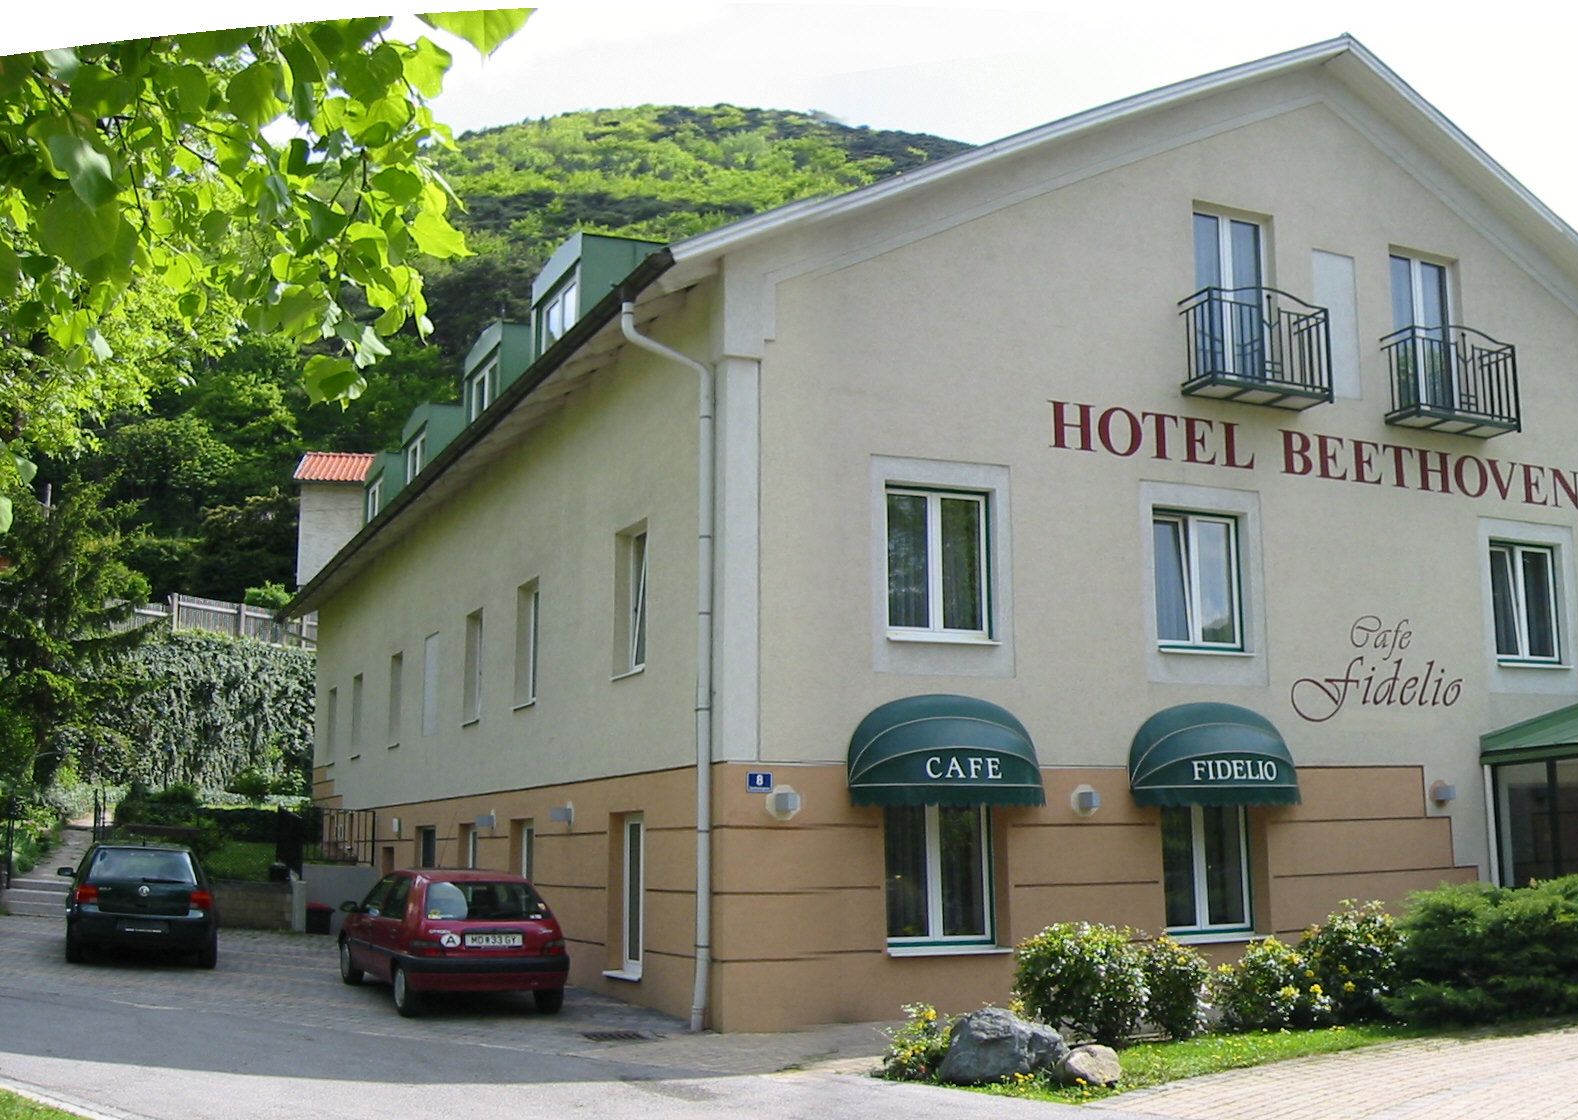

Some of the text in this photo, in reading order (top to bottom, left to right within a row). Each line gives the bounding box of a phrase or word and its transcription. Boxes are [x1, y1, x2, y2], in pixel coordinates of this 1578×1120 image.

[1047, 400, 1255, 470] HOTEL
[1350, 615, 1413, 661] Cafe
[1291, 656, 1463, 723] Fidelio
[925, 756, 1002, 779] CAFE
[1192, 760, 1278, 781] FIDELIO
[756, 774, 764, 786] 8
[445, 935, 457, 945] A
